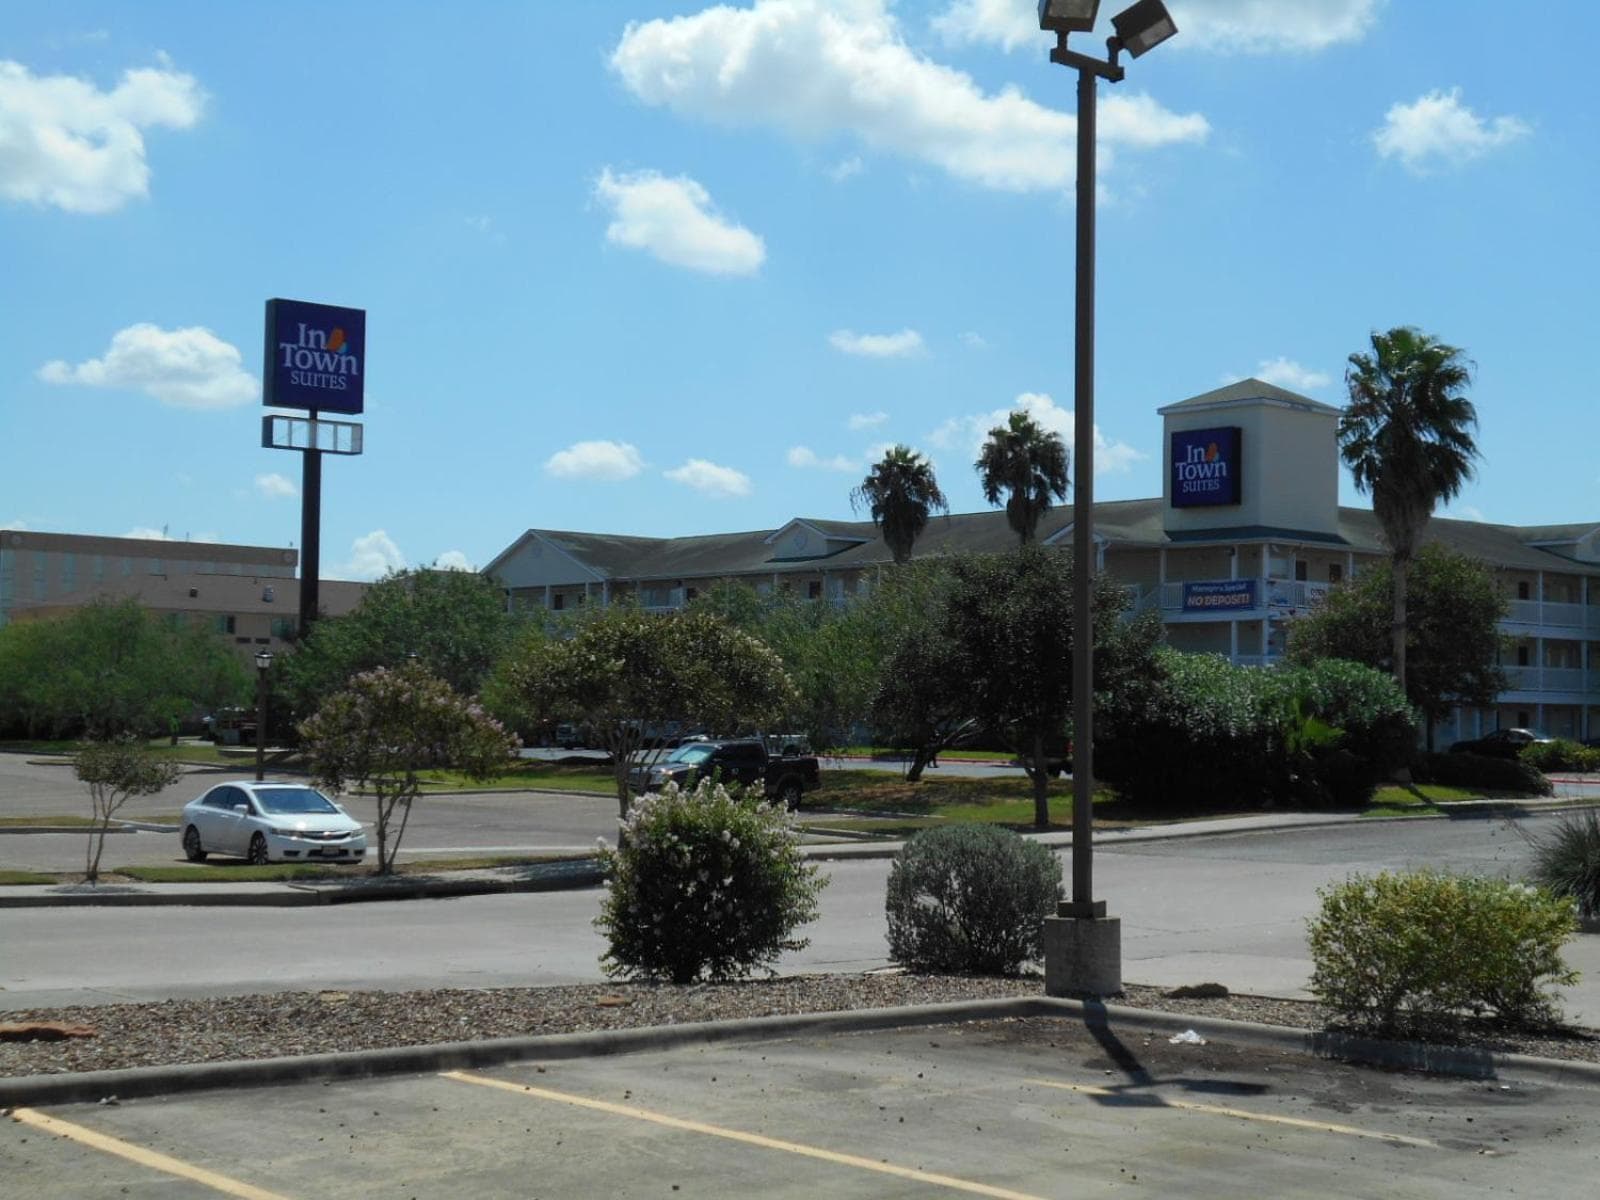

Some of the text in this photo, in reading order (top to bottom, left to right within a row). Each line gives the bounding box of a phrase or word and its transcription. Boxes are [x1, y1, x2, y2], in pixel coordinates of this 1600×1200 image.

[298, 322, 327, 349] In
[290, 370, 347, 390] SUITES
[1187, 444, 1206, 464] In
[1182, 479, 1220, 493] SUITES
[1187, 594, 1203, 606] NO
